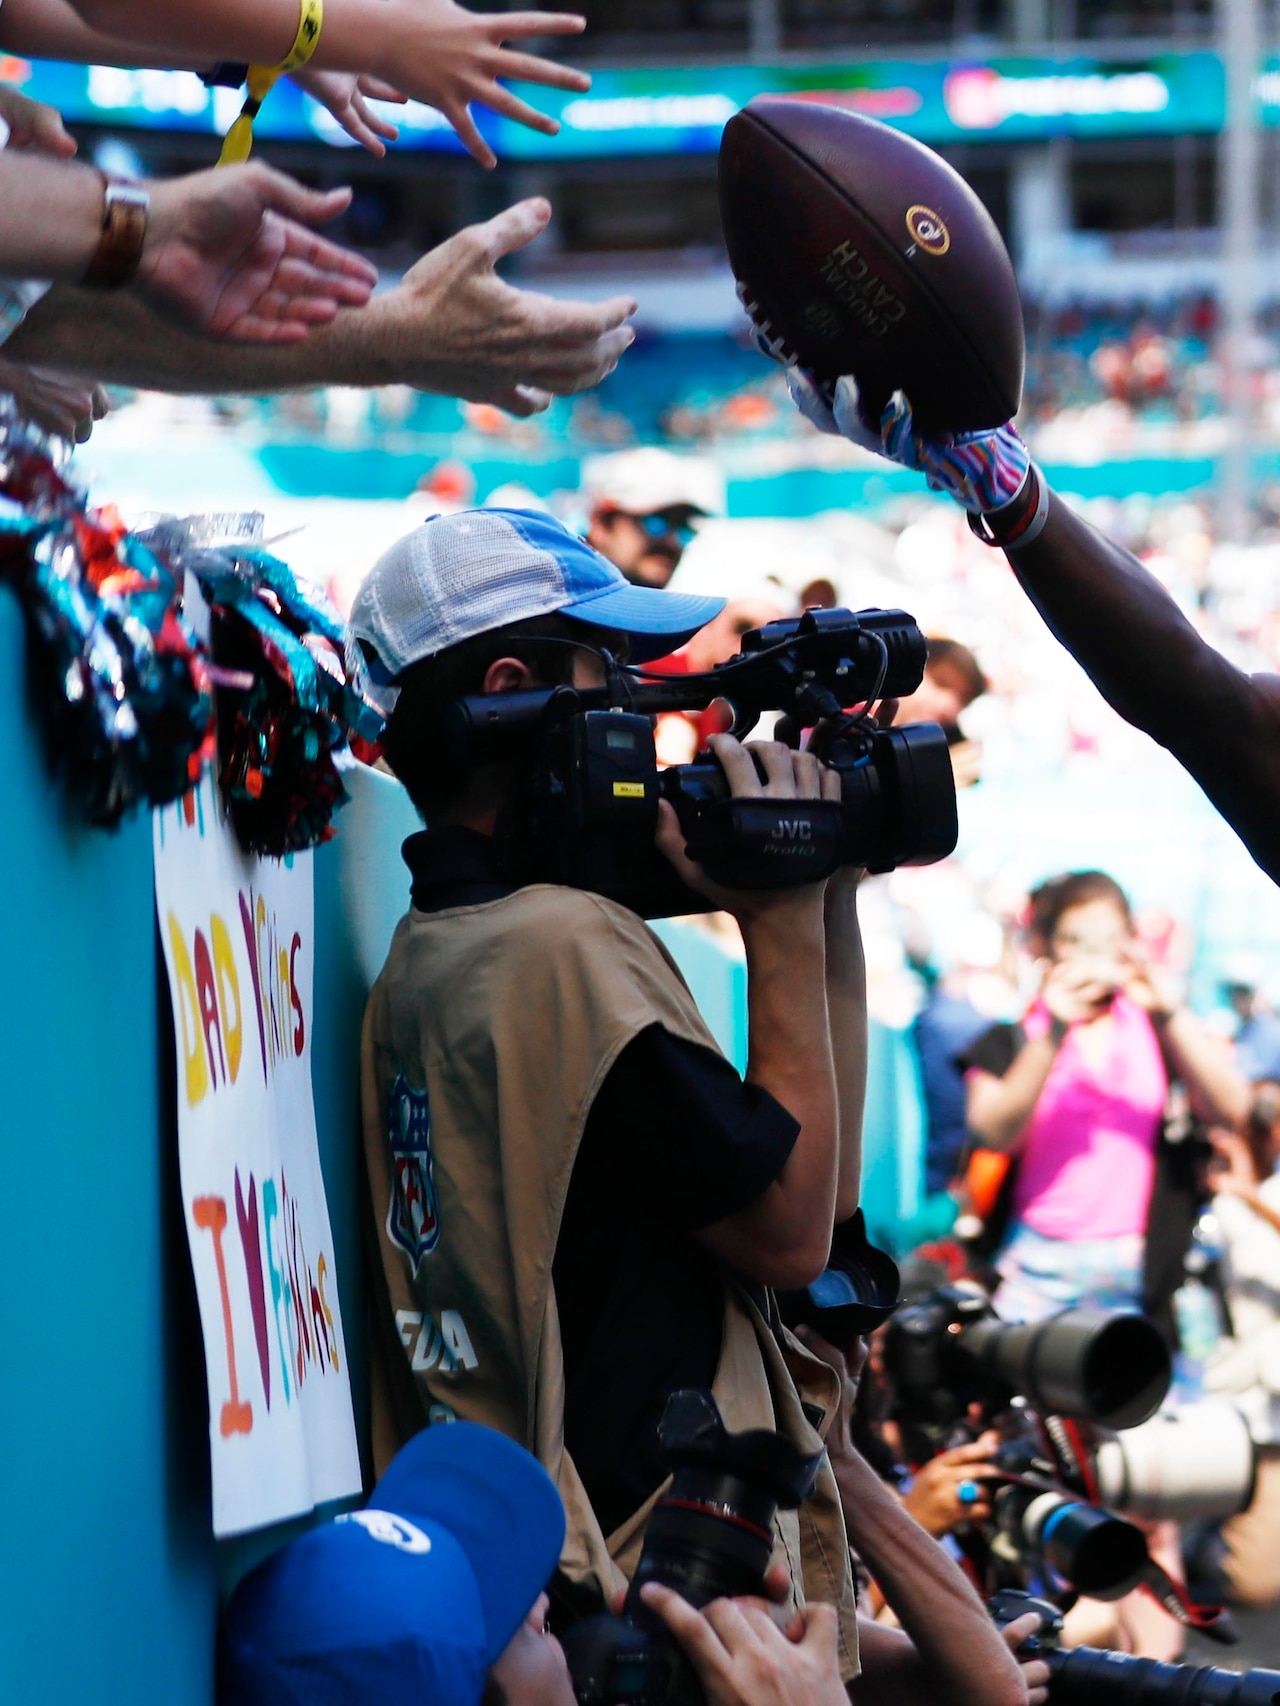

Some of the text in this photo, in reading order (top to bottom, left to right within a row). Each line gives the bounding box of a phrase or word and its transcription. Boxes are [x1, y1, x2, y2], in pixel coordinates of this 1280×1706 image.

[819, 254, 888, 336] CRUCIAL
[832, 239, 907, 324] CATCH
[771, 819, 812, 841] JVC
[167, 907, 242, 1108] DAD
[192, 1194, 253, 1440] I
